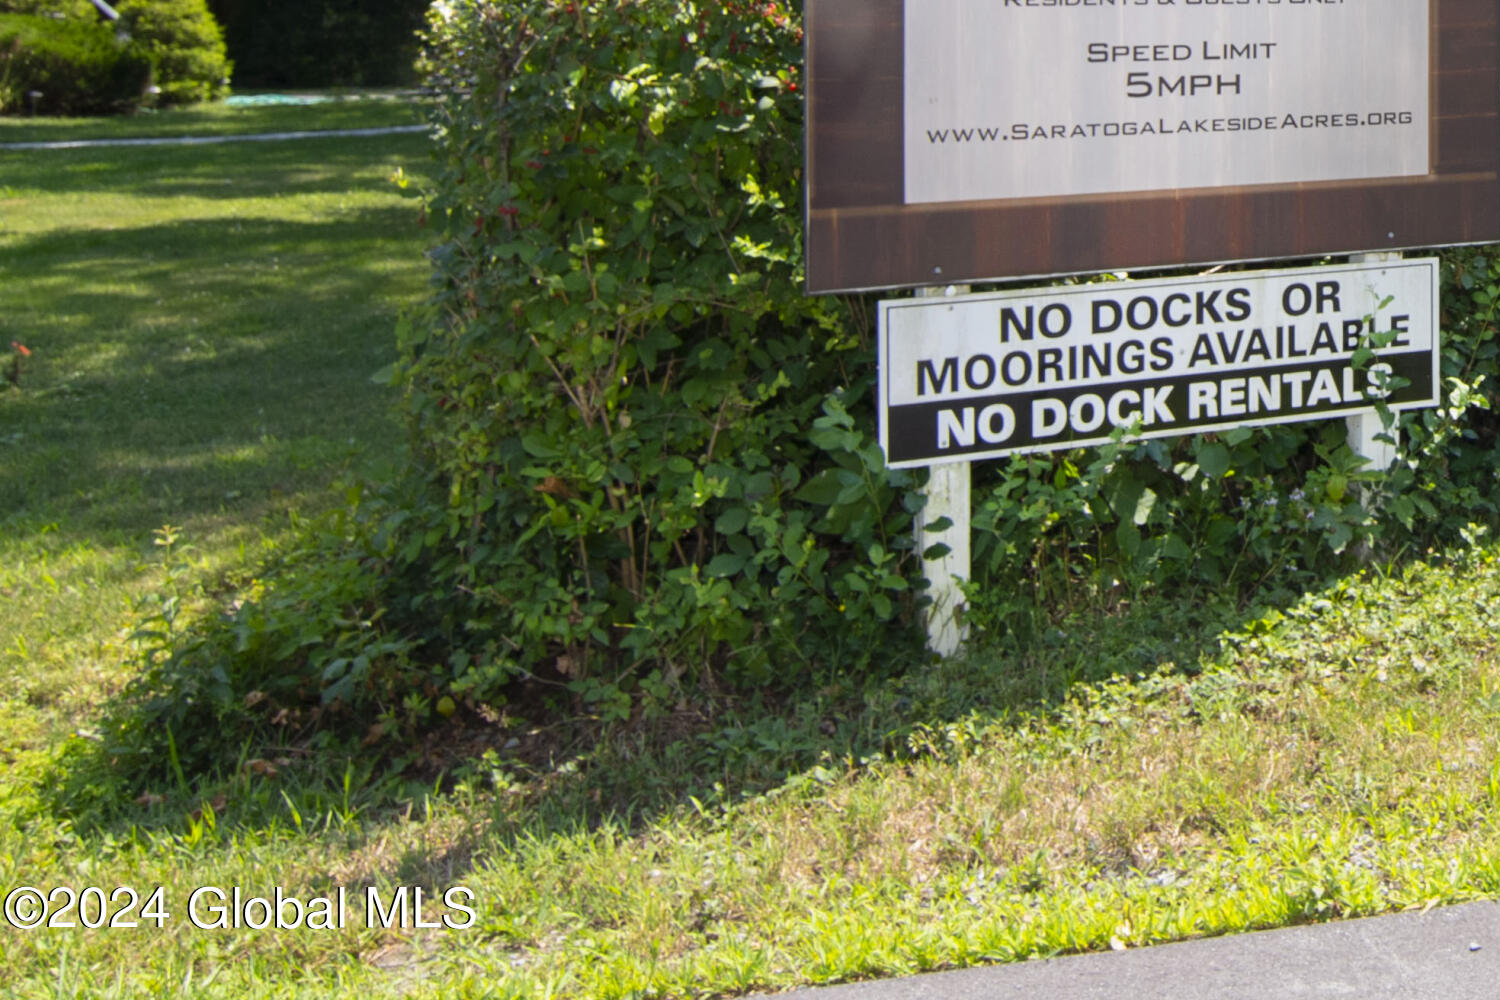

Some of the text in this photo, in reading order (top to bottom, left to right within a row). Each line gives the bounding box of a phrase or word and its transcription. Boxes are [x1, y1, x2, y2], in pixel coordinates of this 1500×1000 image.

[1126, 71, 1242, 98] 5MPH
[1001, 280, 1342, 343] NO DOCKS OR
[916, 336, 1174, 396] MOORINGS
[937, 362, 1394, 450] NO DOCK RENTALS
